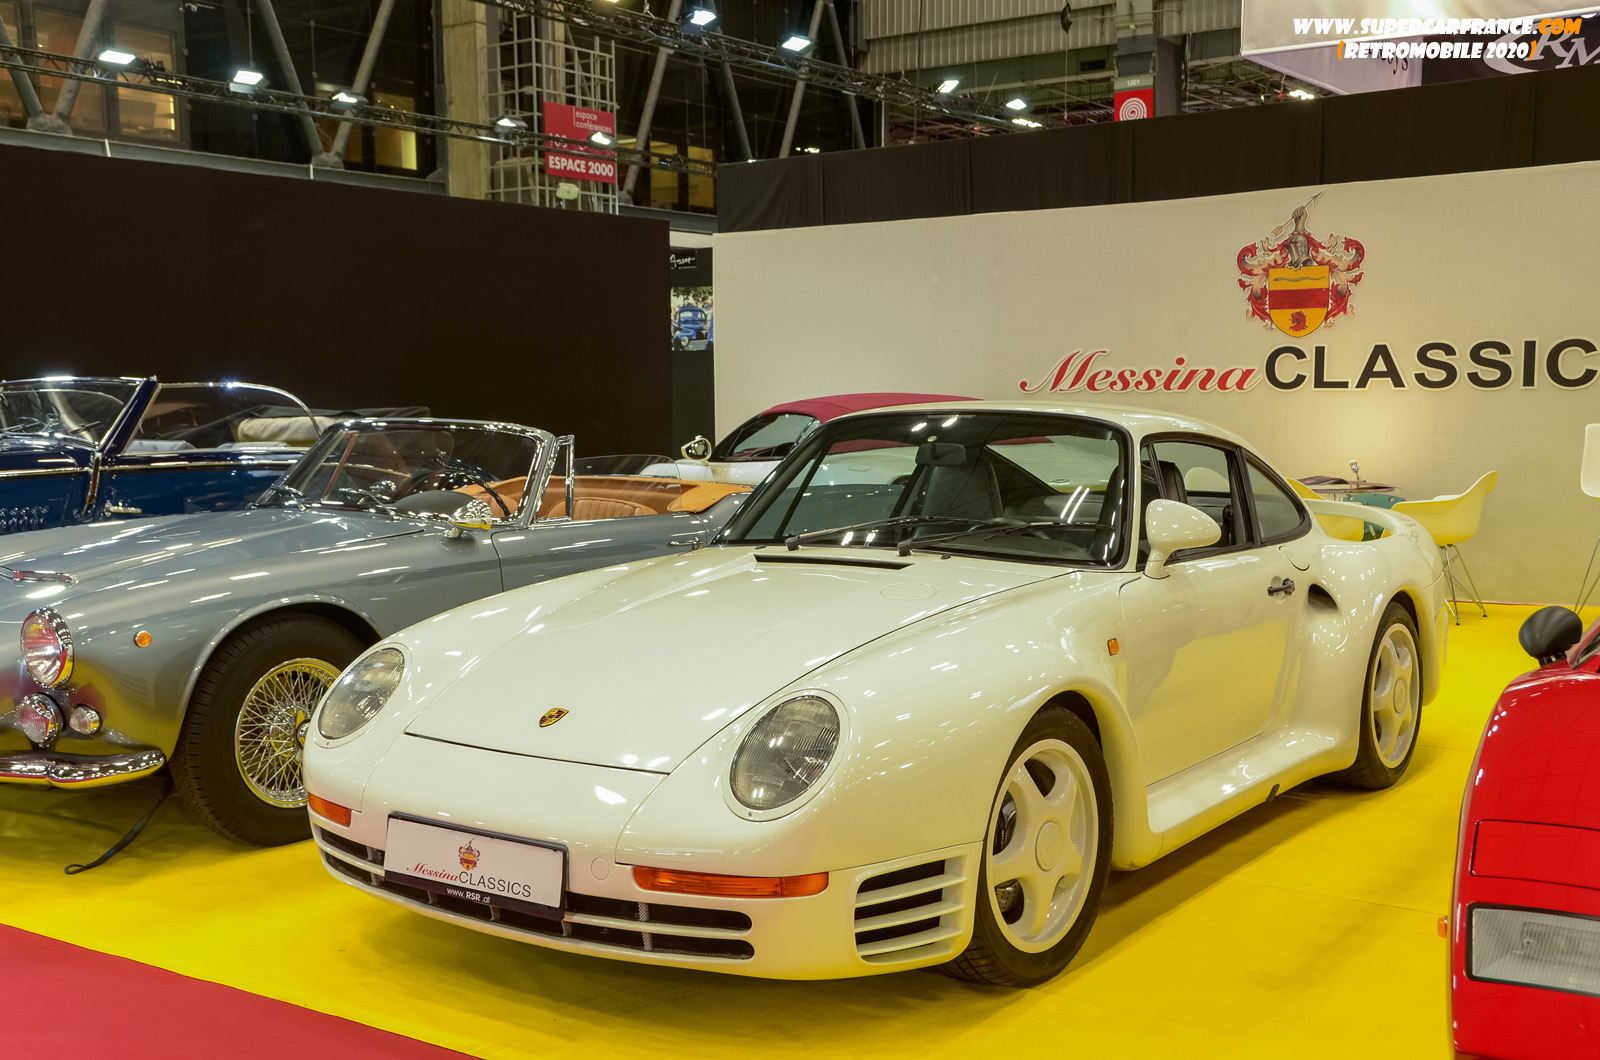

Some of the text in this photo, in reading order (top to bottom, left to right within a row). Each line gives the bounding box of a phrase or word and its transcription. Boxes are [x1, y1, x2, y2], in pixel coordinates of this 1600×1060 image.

[575, 111, 598, 121] espace
[575, 120, 612, 133] conférences
[548, 155, 614, 177] ESPACE 2000
